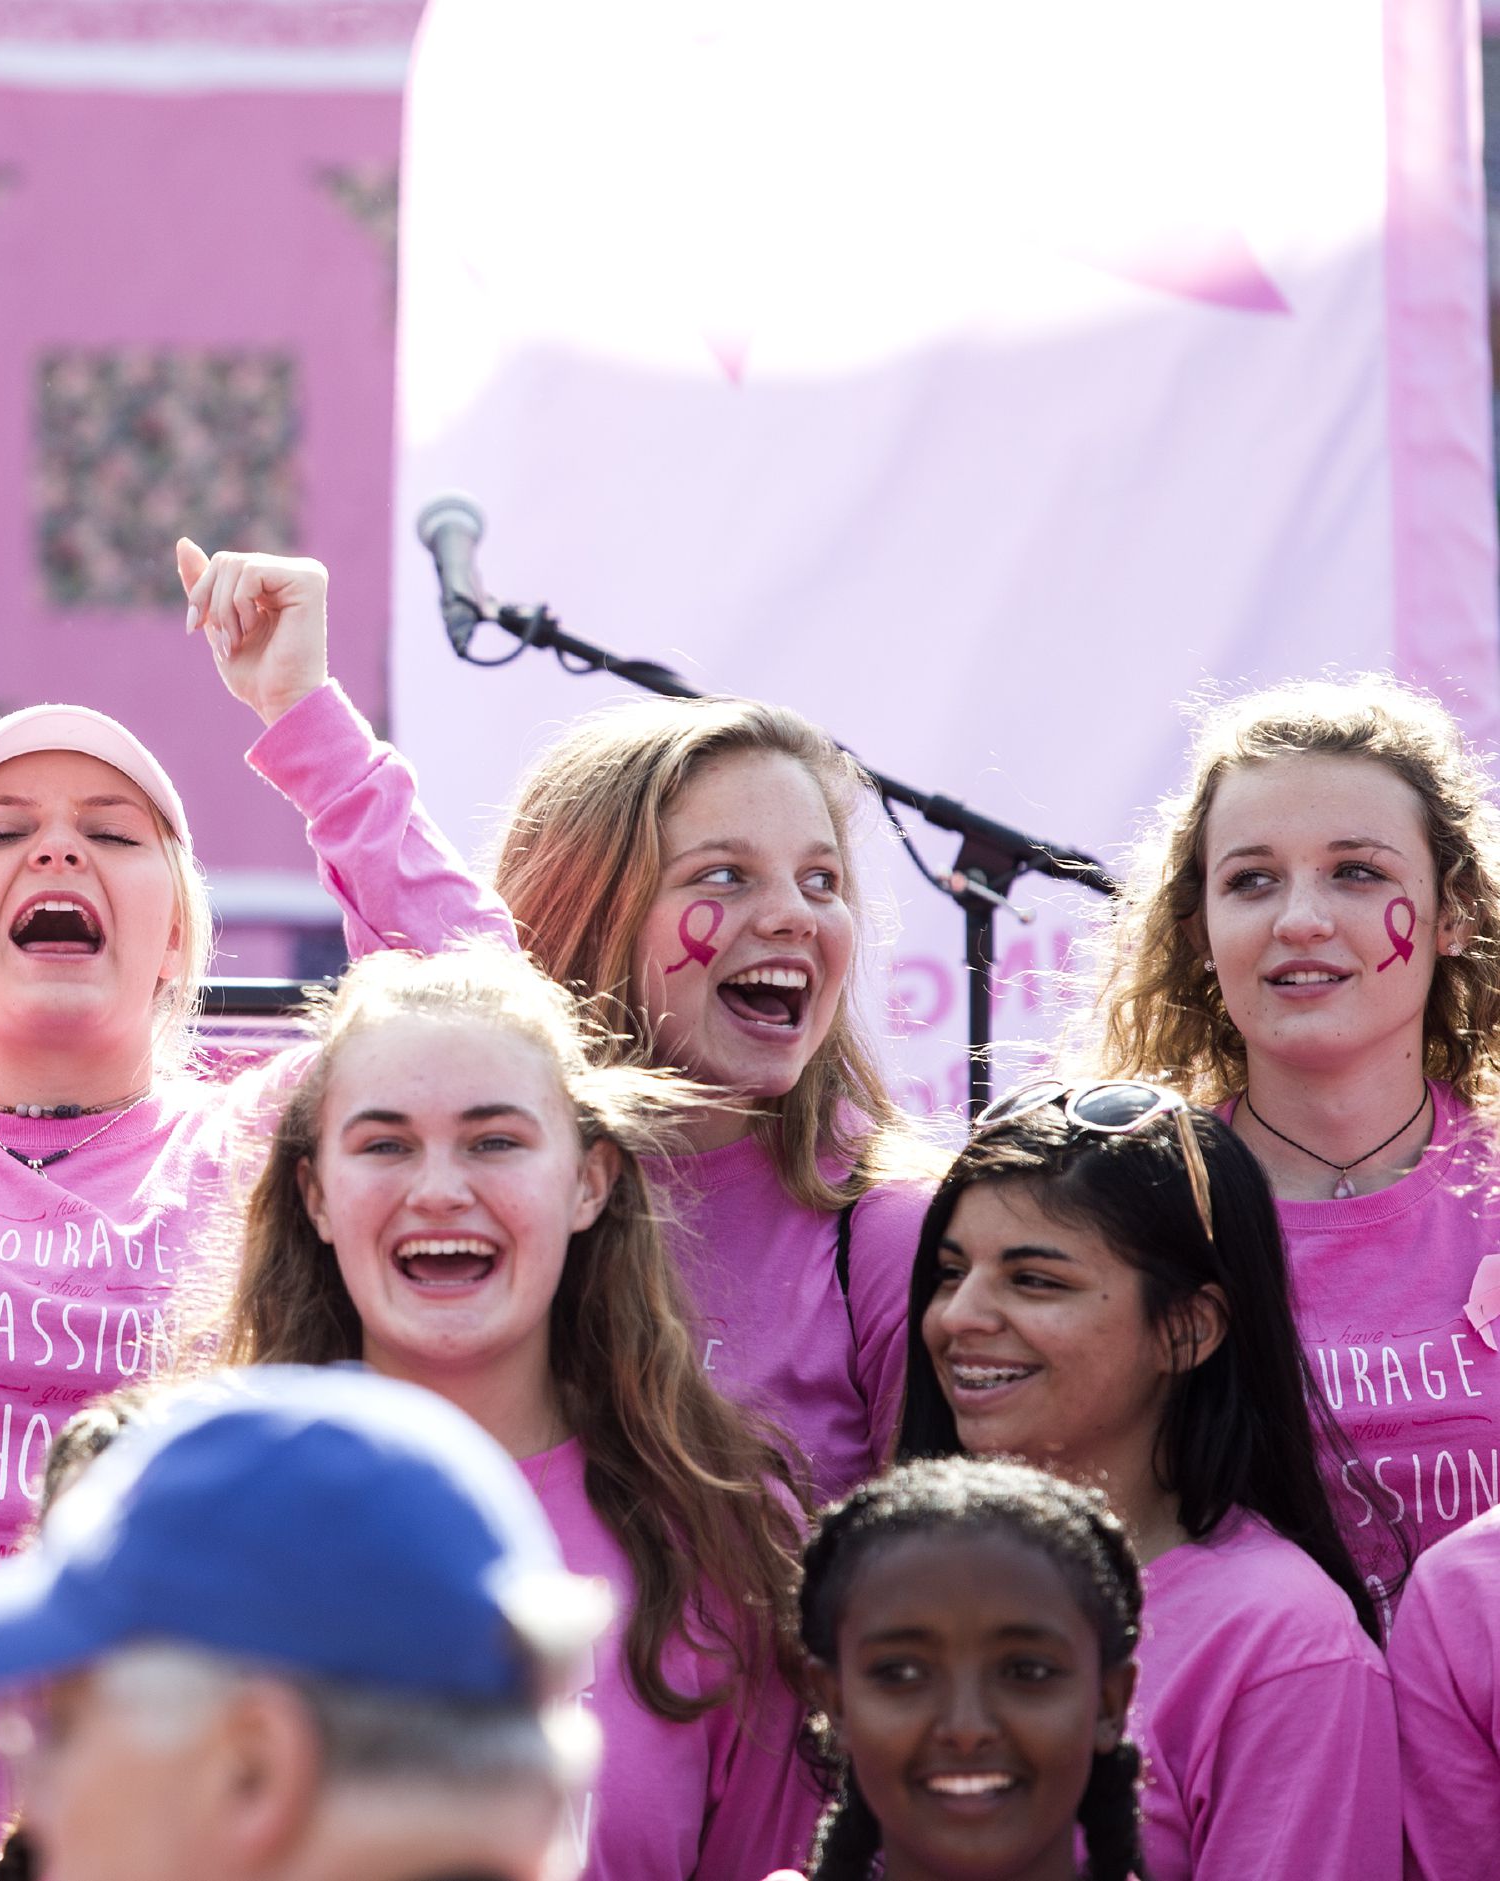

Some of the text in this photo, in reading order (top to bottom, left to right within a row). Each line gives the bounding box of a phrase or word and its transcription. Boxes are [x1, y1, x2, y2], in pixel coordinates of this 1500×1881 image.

[55, 1195, 93, 1217] hav
[47, 1275, 98, 1298] show
[1338, 1325, 1384, 1345] have
[1300, 1334, 1482, 1410] URAGE
[33, 1384, 87, 1407] give
[1352, 1413, 1405, 1440] show
